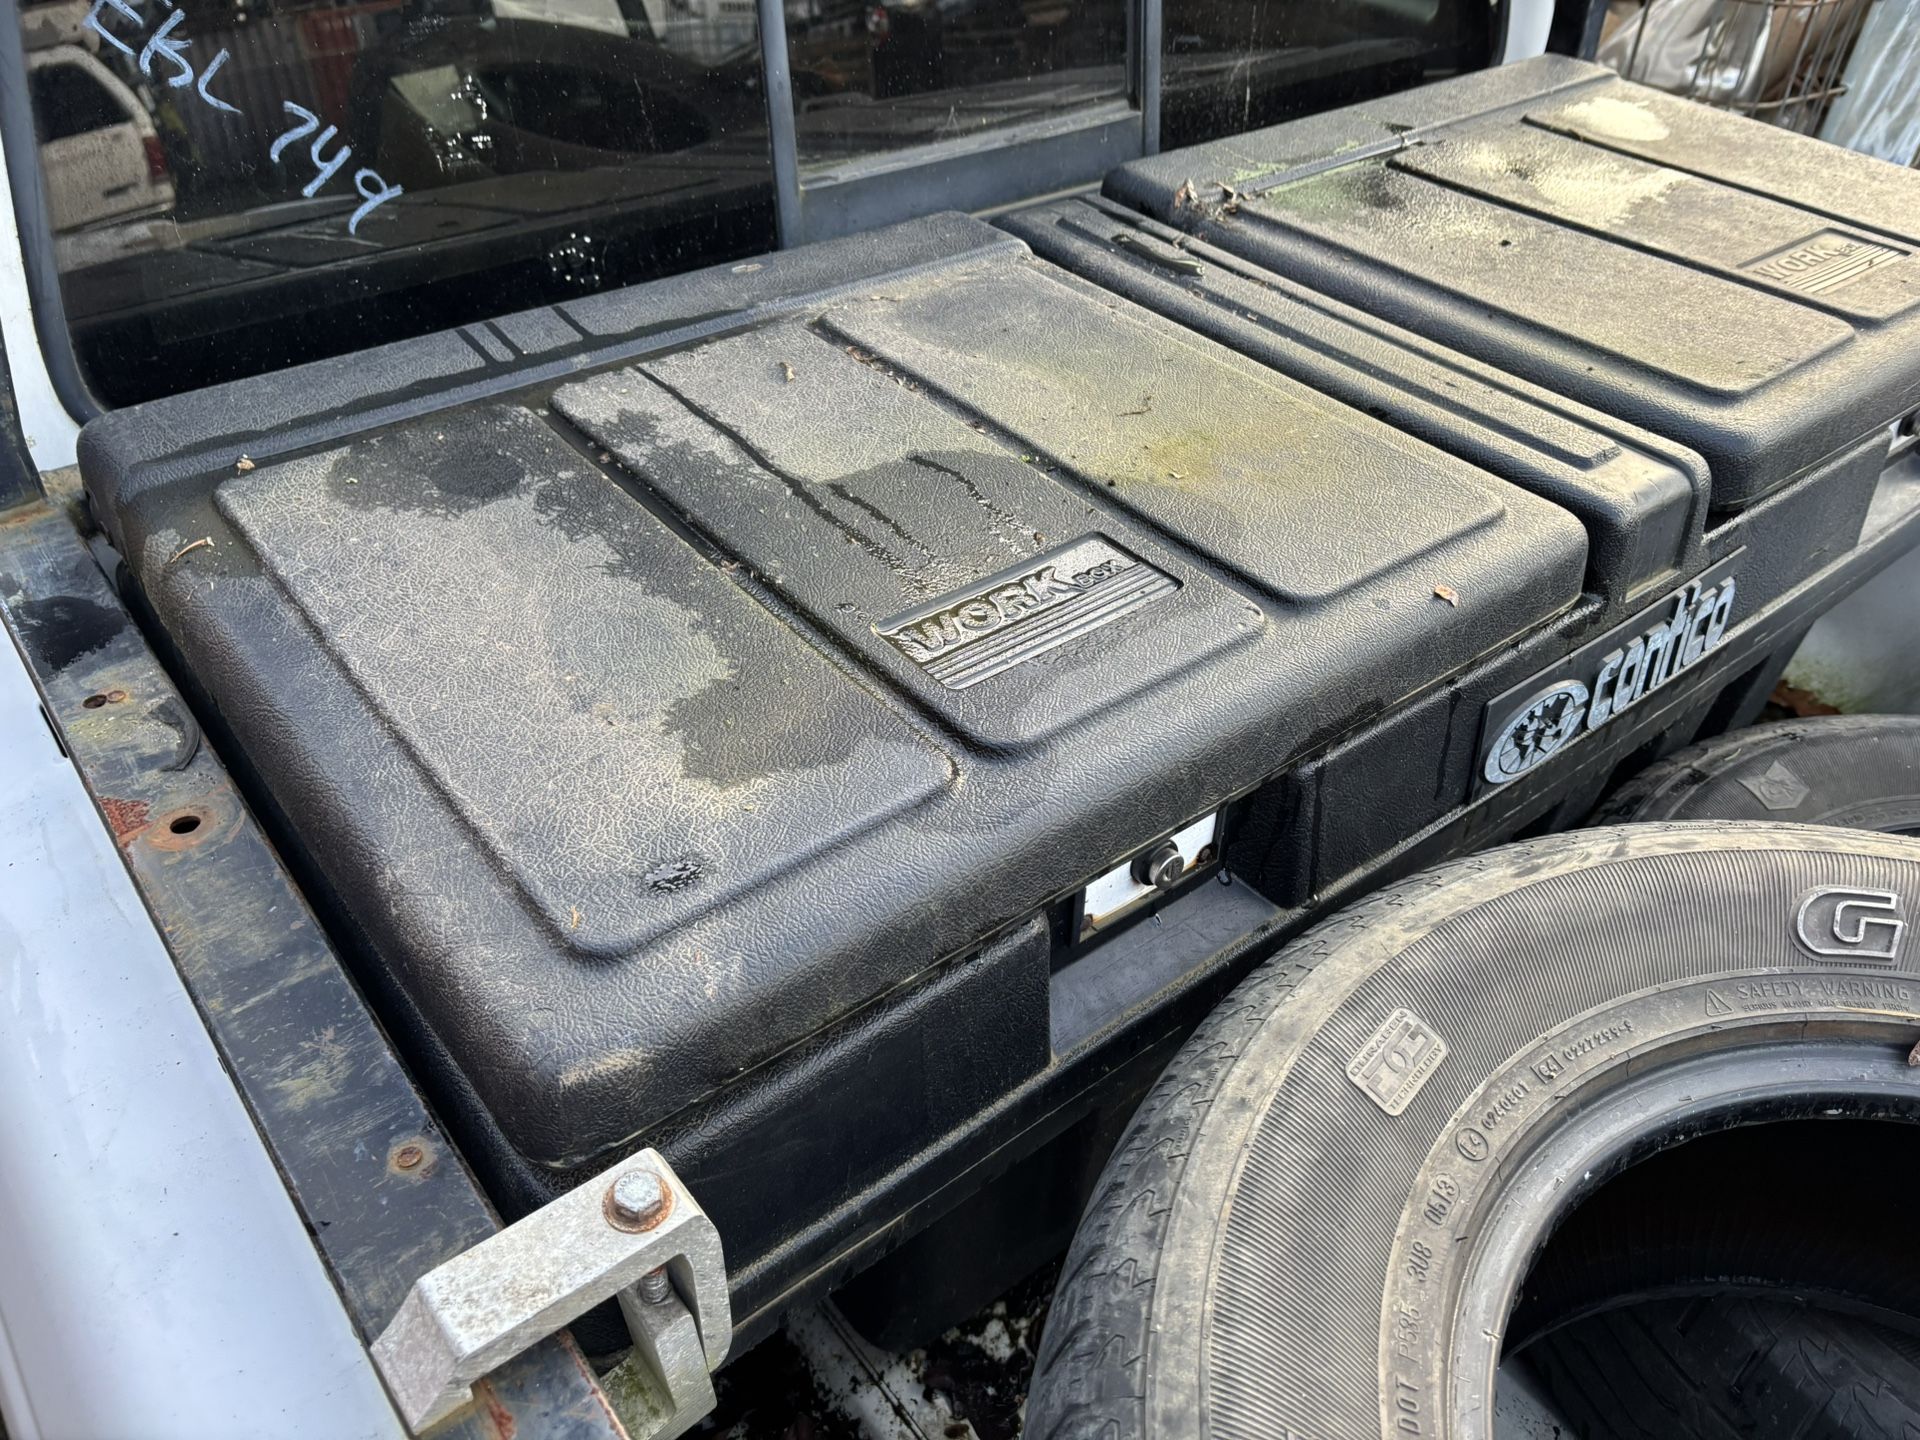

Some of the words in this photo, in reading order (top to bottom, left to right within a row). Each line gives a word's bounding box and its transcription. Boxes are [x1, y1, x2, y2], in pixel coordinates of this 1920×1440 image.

[1753, 245, 1842, 281] WORK
[896, 565, 1085, 651] WORK
[1071, 558, 1125, 589] BOX
[1587, 576, 1736, 730] contico
[1736, 980, 1805, 999] SAFETY
[1819, 980, 1911, 1001] WARNING
[1348, 1009, 1407, 1078] DURAGEN
[1388, 1042, 1442, 1111] TECHNOLOGY
[1395, 1374, 1422, 1437] DOT
